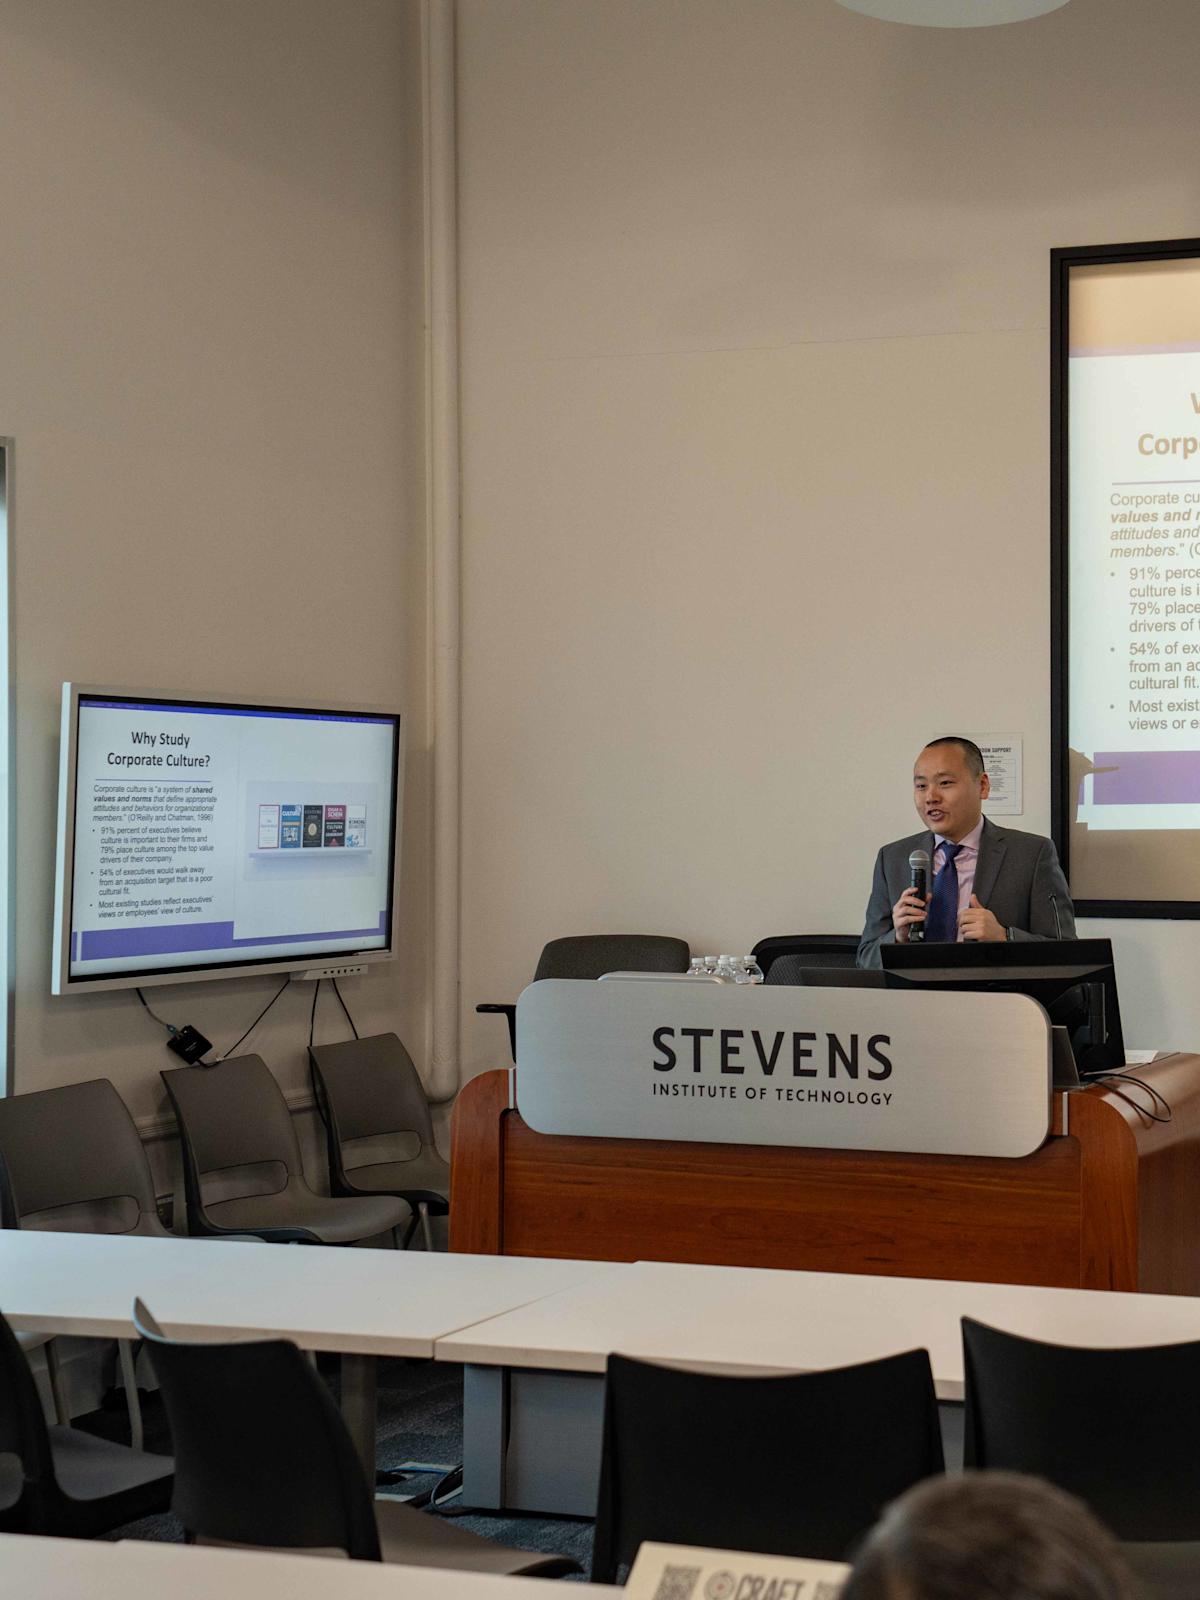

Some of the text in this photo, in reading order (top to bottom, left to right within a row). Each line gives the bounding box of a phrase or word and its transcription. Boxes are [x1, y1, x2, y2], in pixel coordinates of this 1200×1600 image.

[1110, 490, 1179, 509] Corporate
[1111, 508, 1158, 523] values
[1163, 507, 1191, 522] and
[1110, 525, 1169, 541] attitudes
[1173, 524, 1200, 539] and
[1129, 566, 1160, 581] 91%
[1129, 583, 1176, 598] culture
[1181, 582, 1192, 596] is
[1130, 601, 1160, 615] 79%
[1129, 618, 1176, 633] drivers
[1180, 618, 1194, 632] of
[1129, 641, 1160, 656] 54%
[1164, 641, 1178, 655] of
[1129, 659, 1160, 673] from
[1164, 661, 1181, 672] an
[1128, 675, 1199, 690] cultural fit.
[1129, 698, 1163, 713] Most
[1128, 716, 1167, 730] views
[1172, 718, 1186, 730] or
[131, 731, 189, 748] Why Study
[107, 752, 210, 769] Corporate Culture?
[652, 1026, 893, 1081] STEVENS
[652, 1083, 893, 1105] INSTITUTE OF TECHNOLOGY
[734, 1574, 806, 1600] CRAFT
